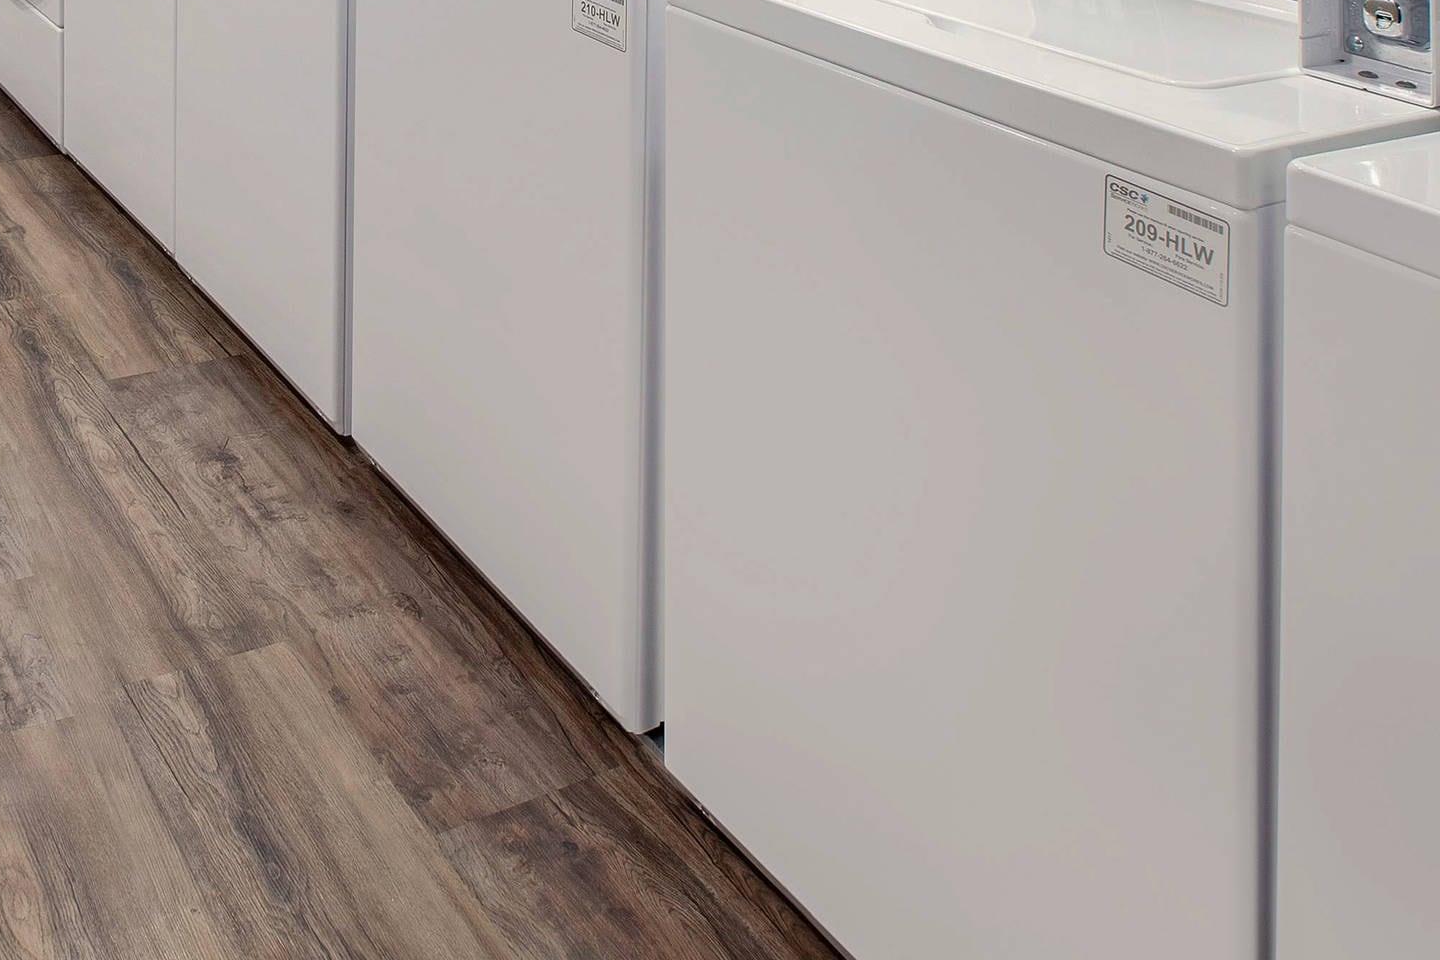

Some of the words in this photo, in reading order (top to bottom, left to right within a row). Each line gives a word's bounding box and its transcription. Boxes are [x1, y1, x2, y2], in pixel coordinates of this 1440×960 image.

[581, 0, 620, 28] 210-HLW
[1109, 182, 1140, 200] CSC
[1124, 214, 1214, 266] 209-HLW
